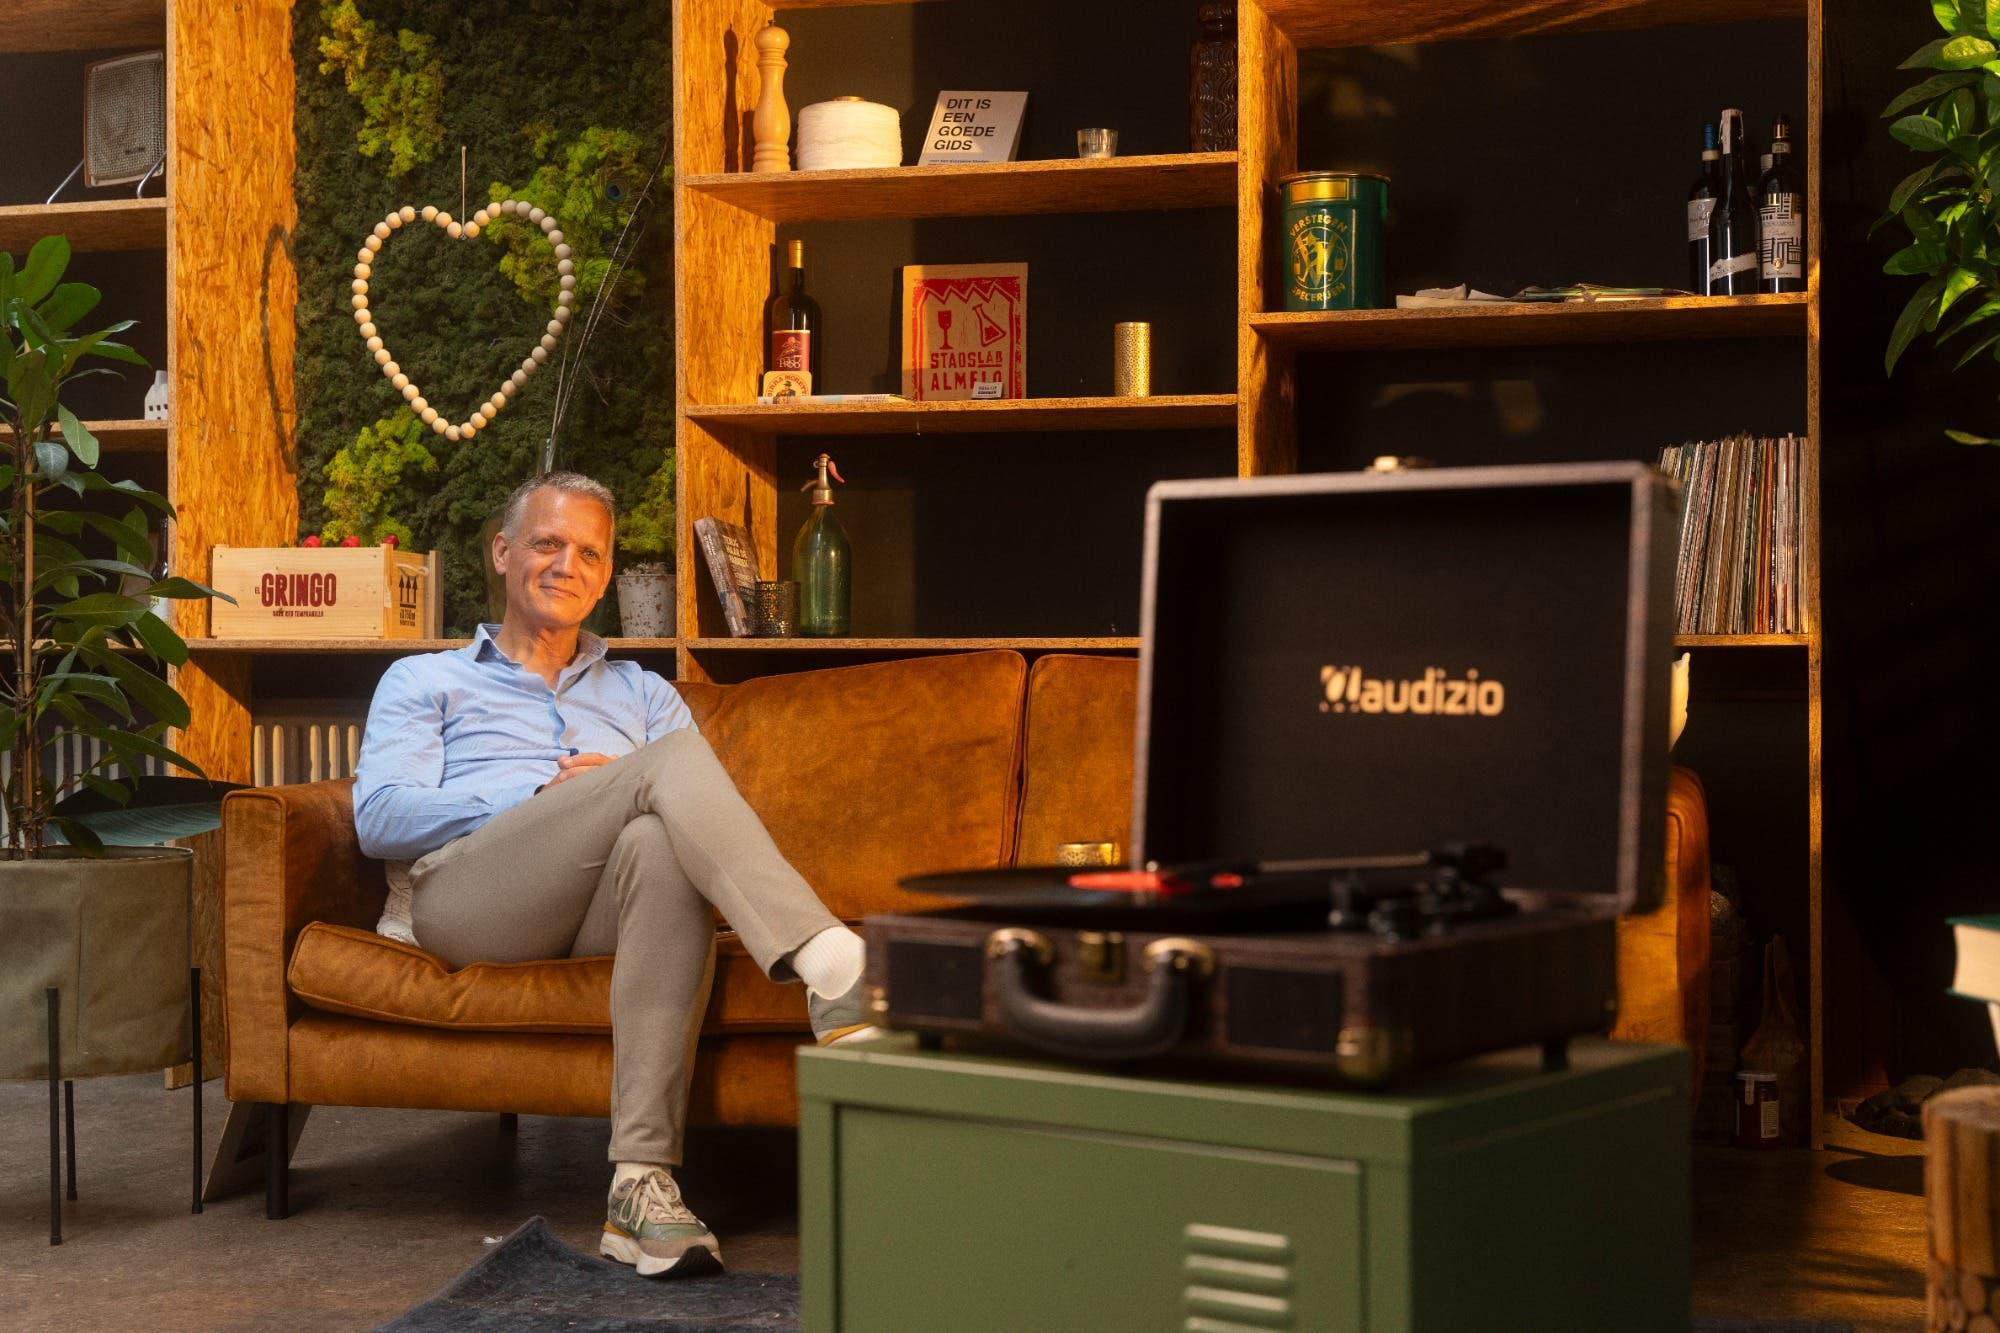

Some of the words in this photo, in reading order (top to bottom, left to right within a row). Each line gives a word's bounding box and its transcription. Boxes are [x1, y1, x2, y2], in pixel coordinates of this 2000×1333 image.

[946, 98, 973, 109] DIT
[976, 98, 991, 109] IS
[942, 112, 975, 123] EEN
[938, 126, 995, 137] GOEDE
[933, 139, 973, 151] GIDS
[930, 351, 1003, 369] STADSLAB
[255, 586, 260, 595] EL
[261, 573, 337, 607] GRINGO
[1360, 666, 1504, 716] audizio
